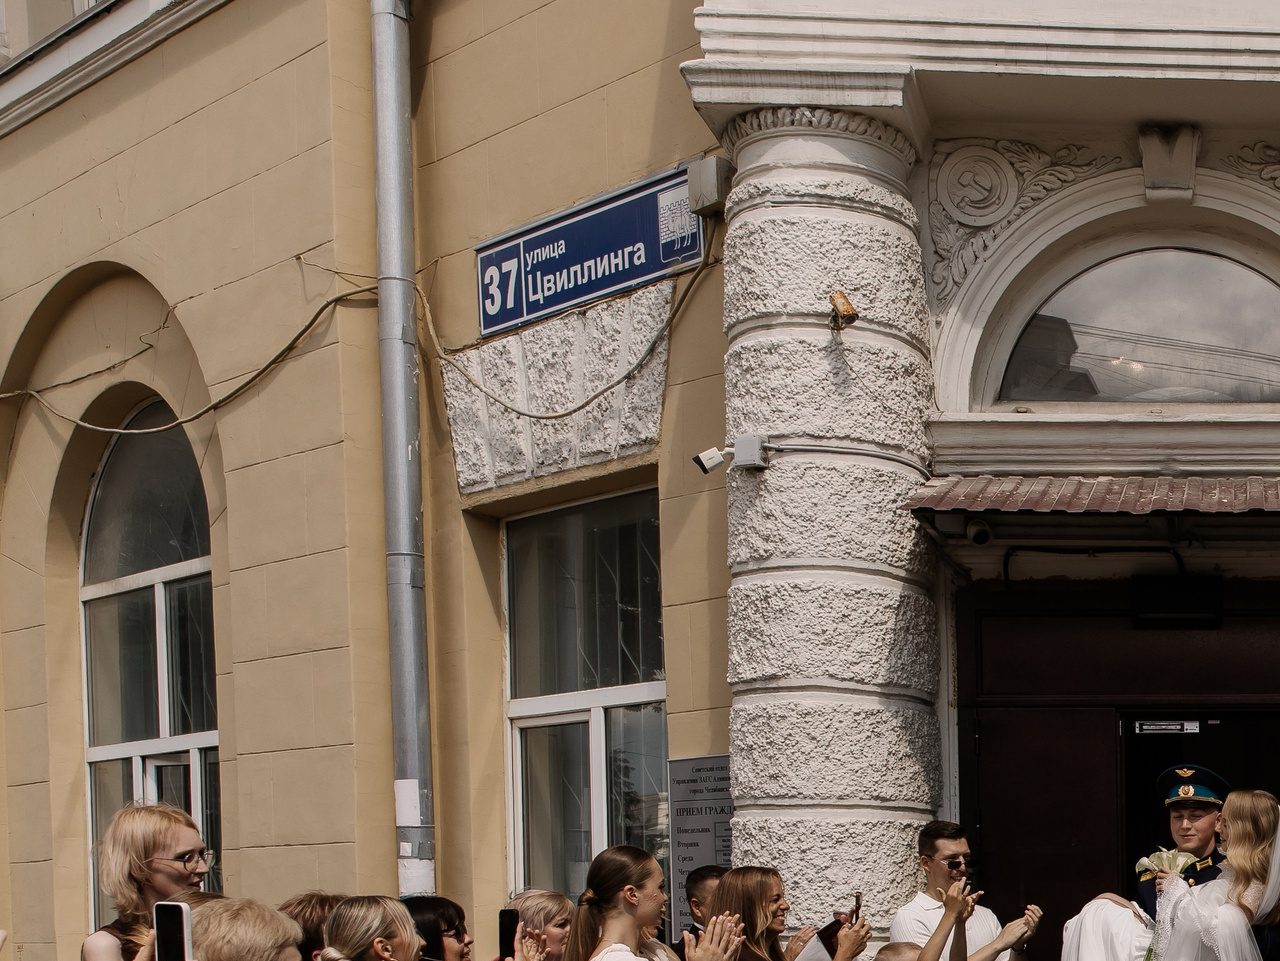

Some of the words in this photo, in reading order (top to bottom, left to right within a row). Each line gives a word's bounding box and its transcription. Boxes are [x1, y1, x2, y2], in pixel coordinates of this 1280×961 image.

[525, 240, 566, 271] улица
[527, 242, 646, 304] Цвиллинга
[484, 258, 518, 315] 37
[676, 806, 703, 816] ПРИЕМ
[676, 826, 711, 834] Понедельник
[677, 841, 700, 849] Вторник
[677, 854, 694, 863] Среда
